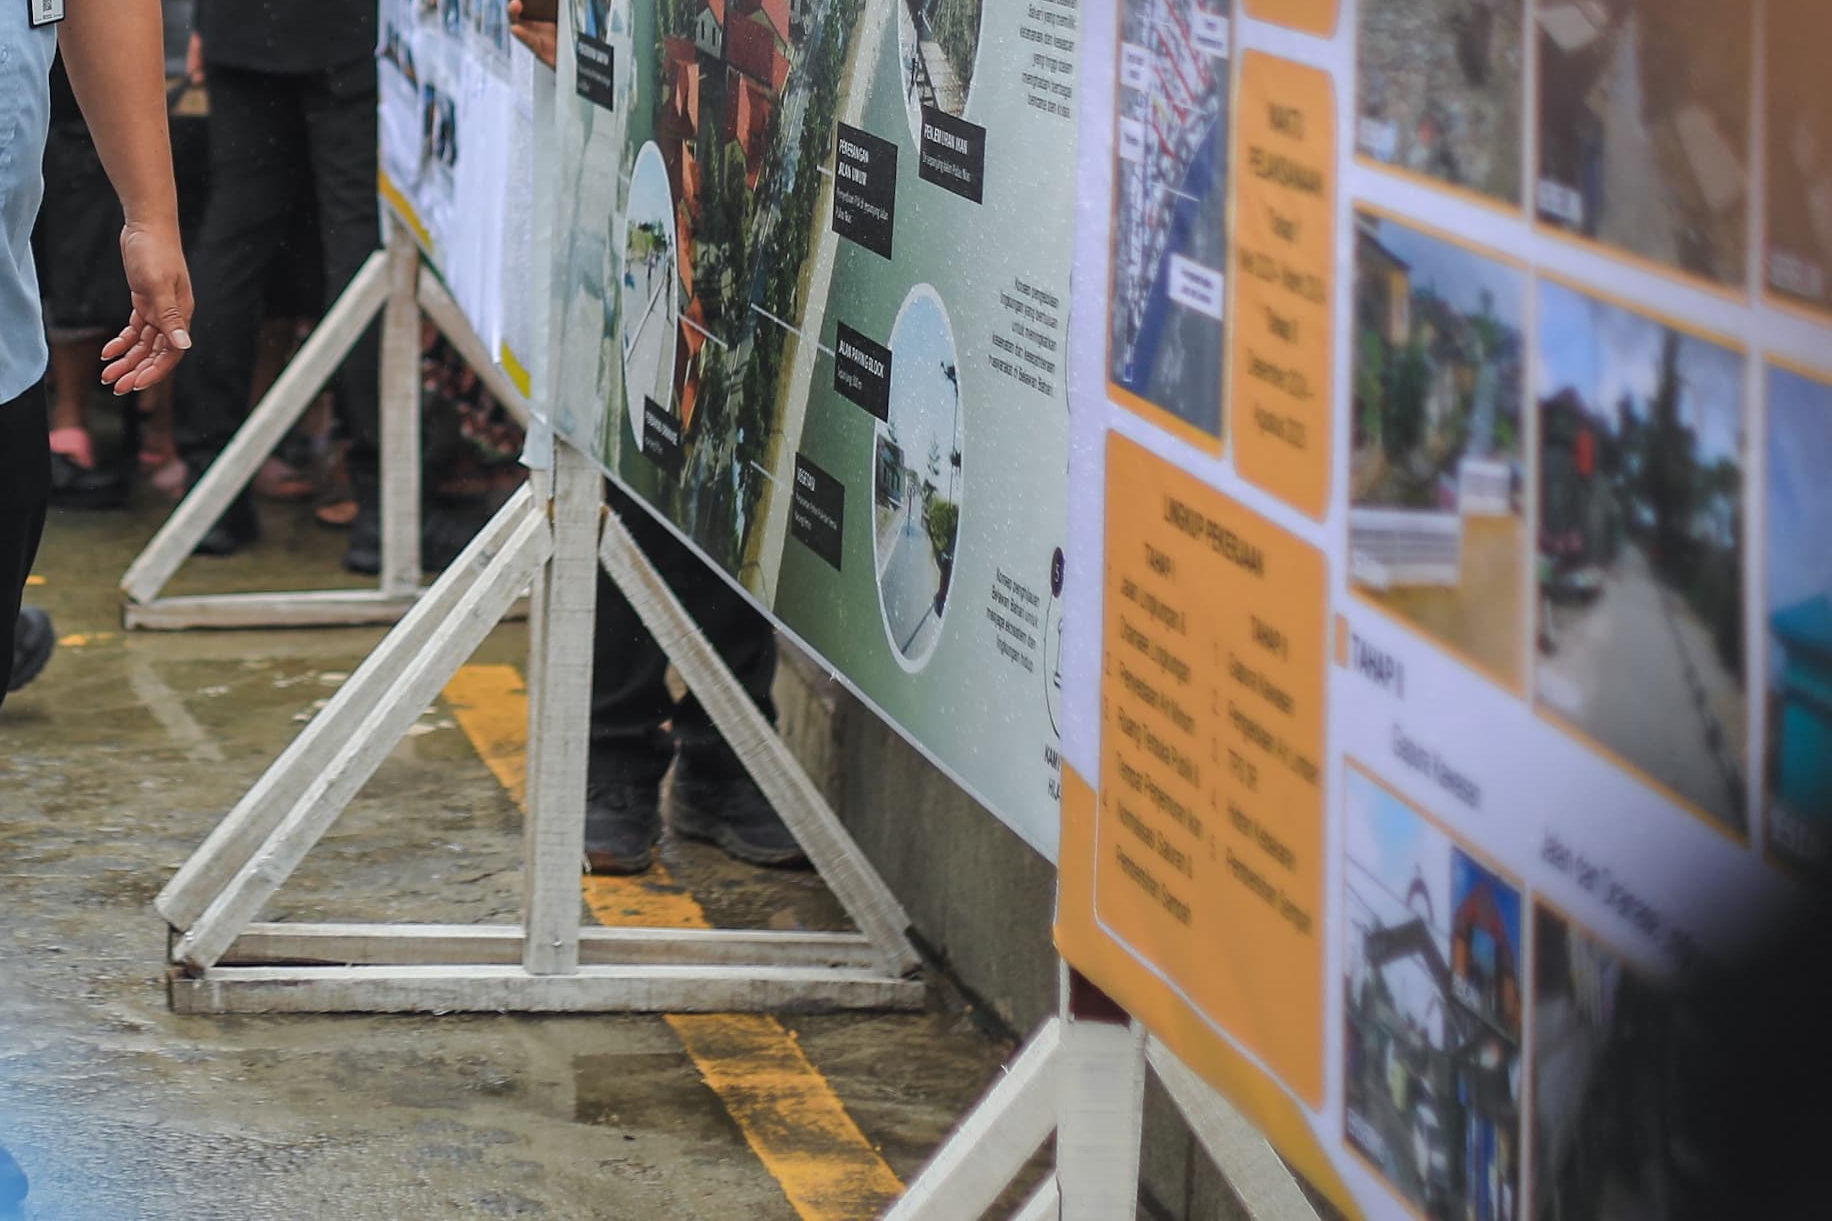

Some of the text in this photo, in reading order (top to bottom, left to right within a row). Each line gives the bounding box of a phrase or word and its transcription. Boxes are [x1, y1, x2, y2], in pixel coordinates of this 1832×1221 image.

[868, 354, 884, 379] BLOCK
[1054, 562, 1060, 584] 5
[1351, 631, 1395, 690] TAHAP
